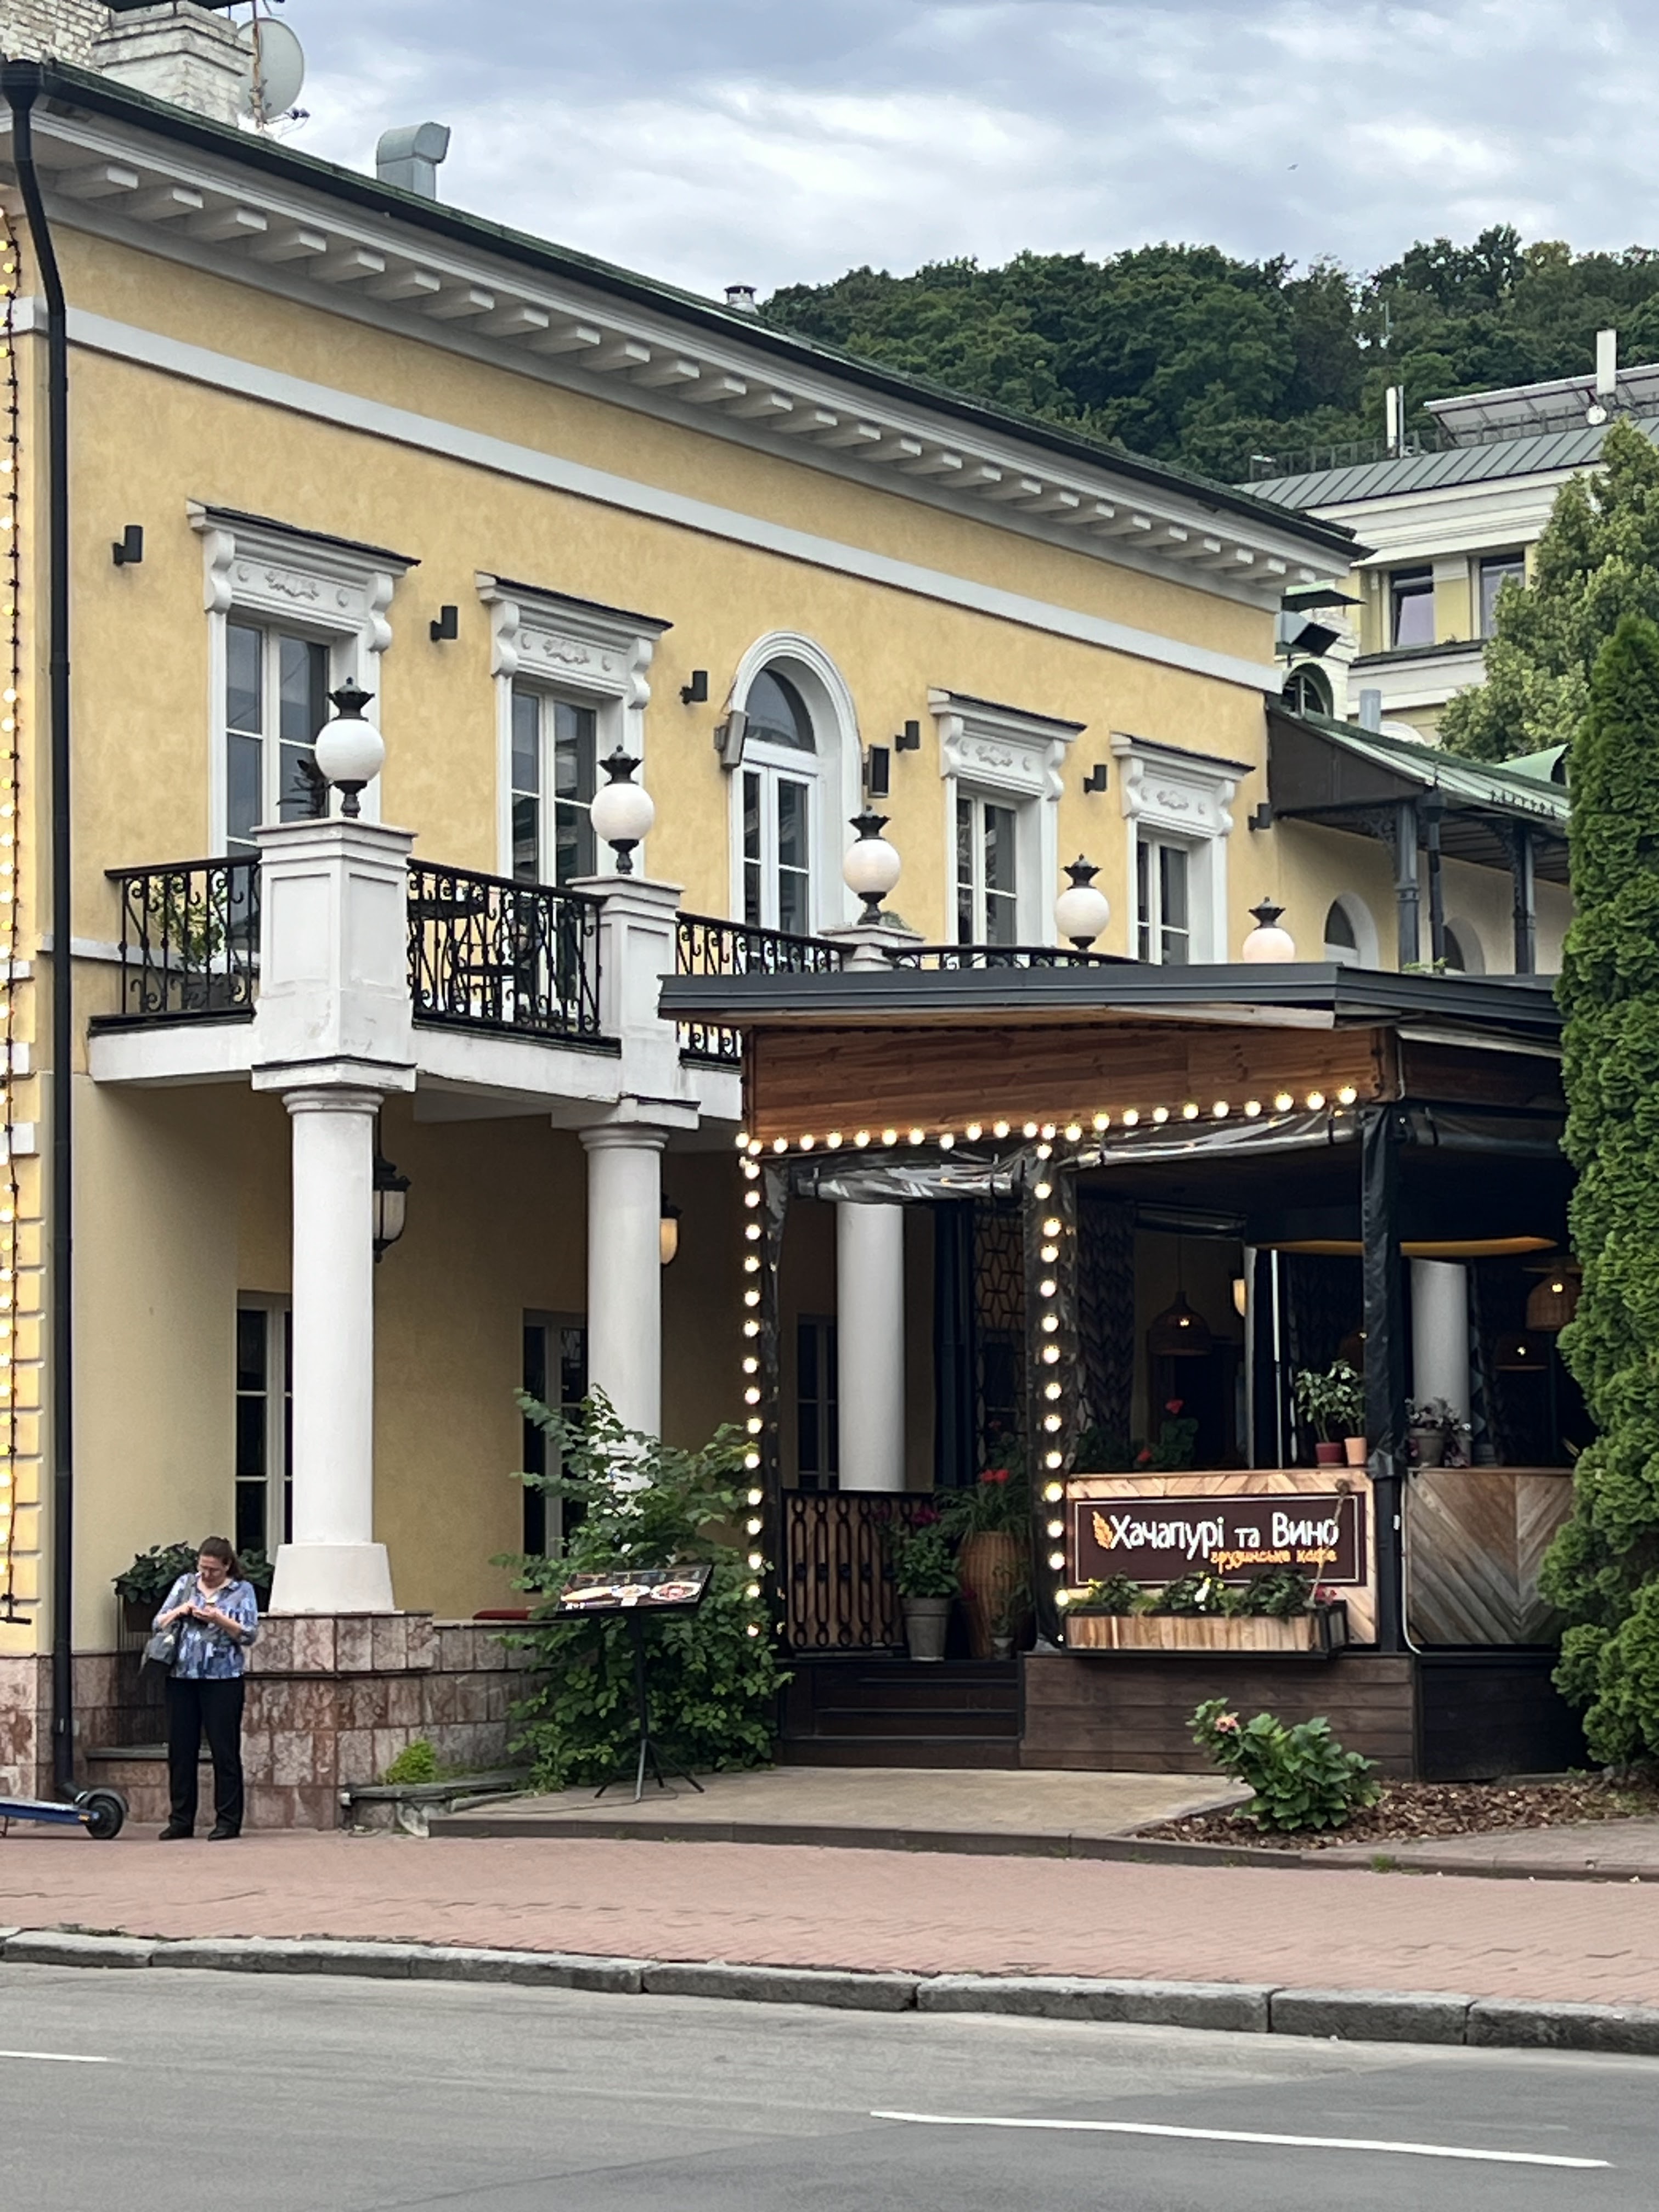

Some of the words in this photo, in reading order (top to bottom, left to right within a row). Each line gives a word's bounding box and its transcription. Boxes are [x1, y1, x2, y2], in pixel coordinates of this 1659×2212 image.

[1109, 1515, 1224, 1560] Хачапурі
[1234, 1527, 1260, 1547] та
[1272, 1512, 1339, 1548] Вино
